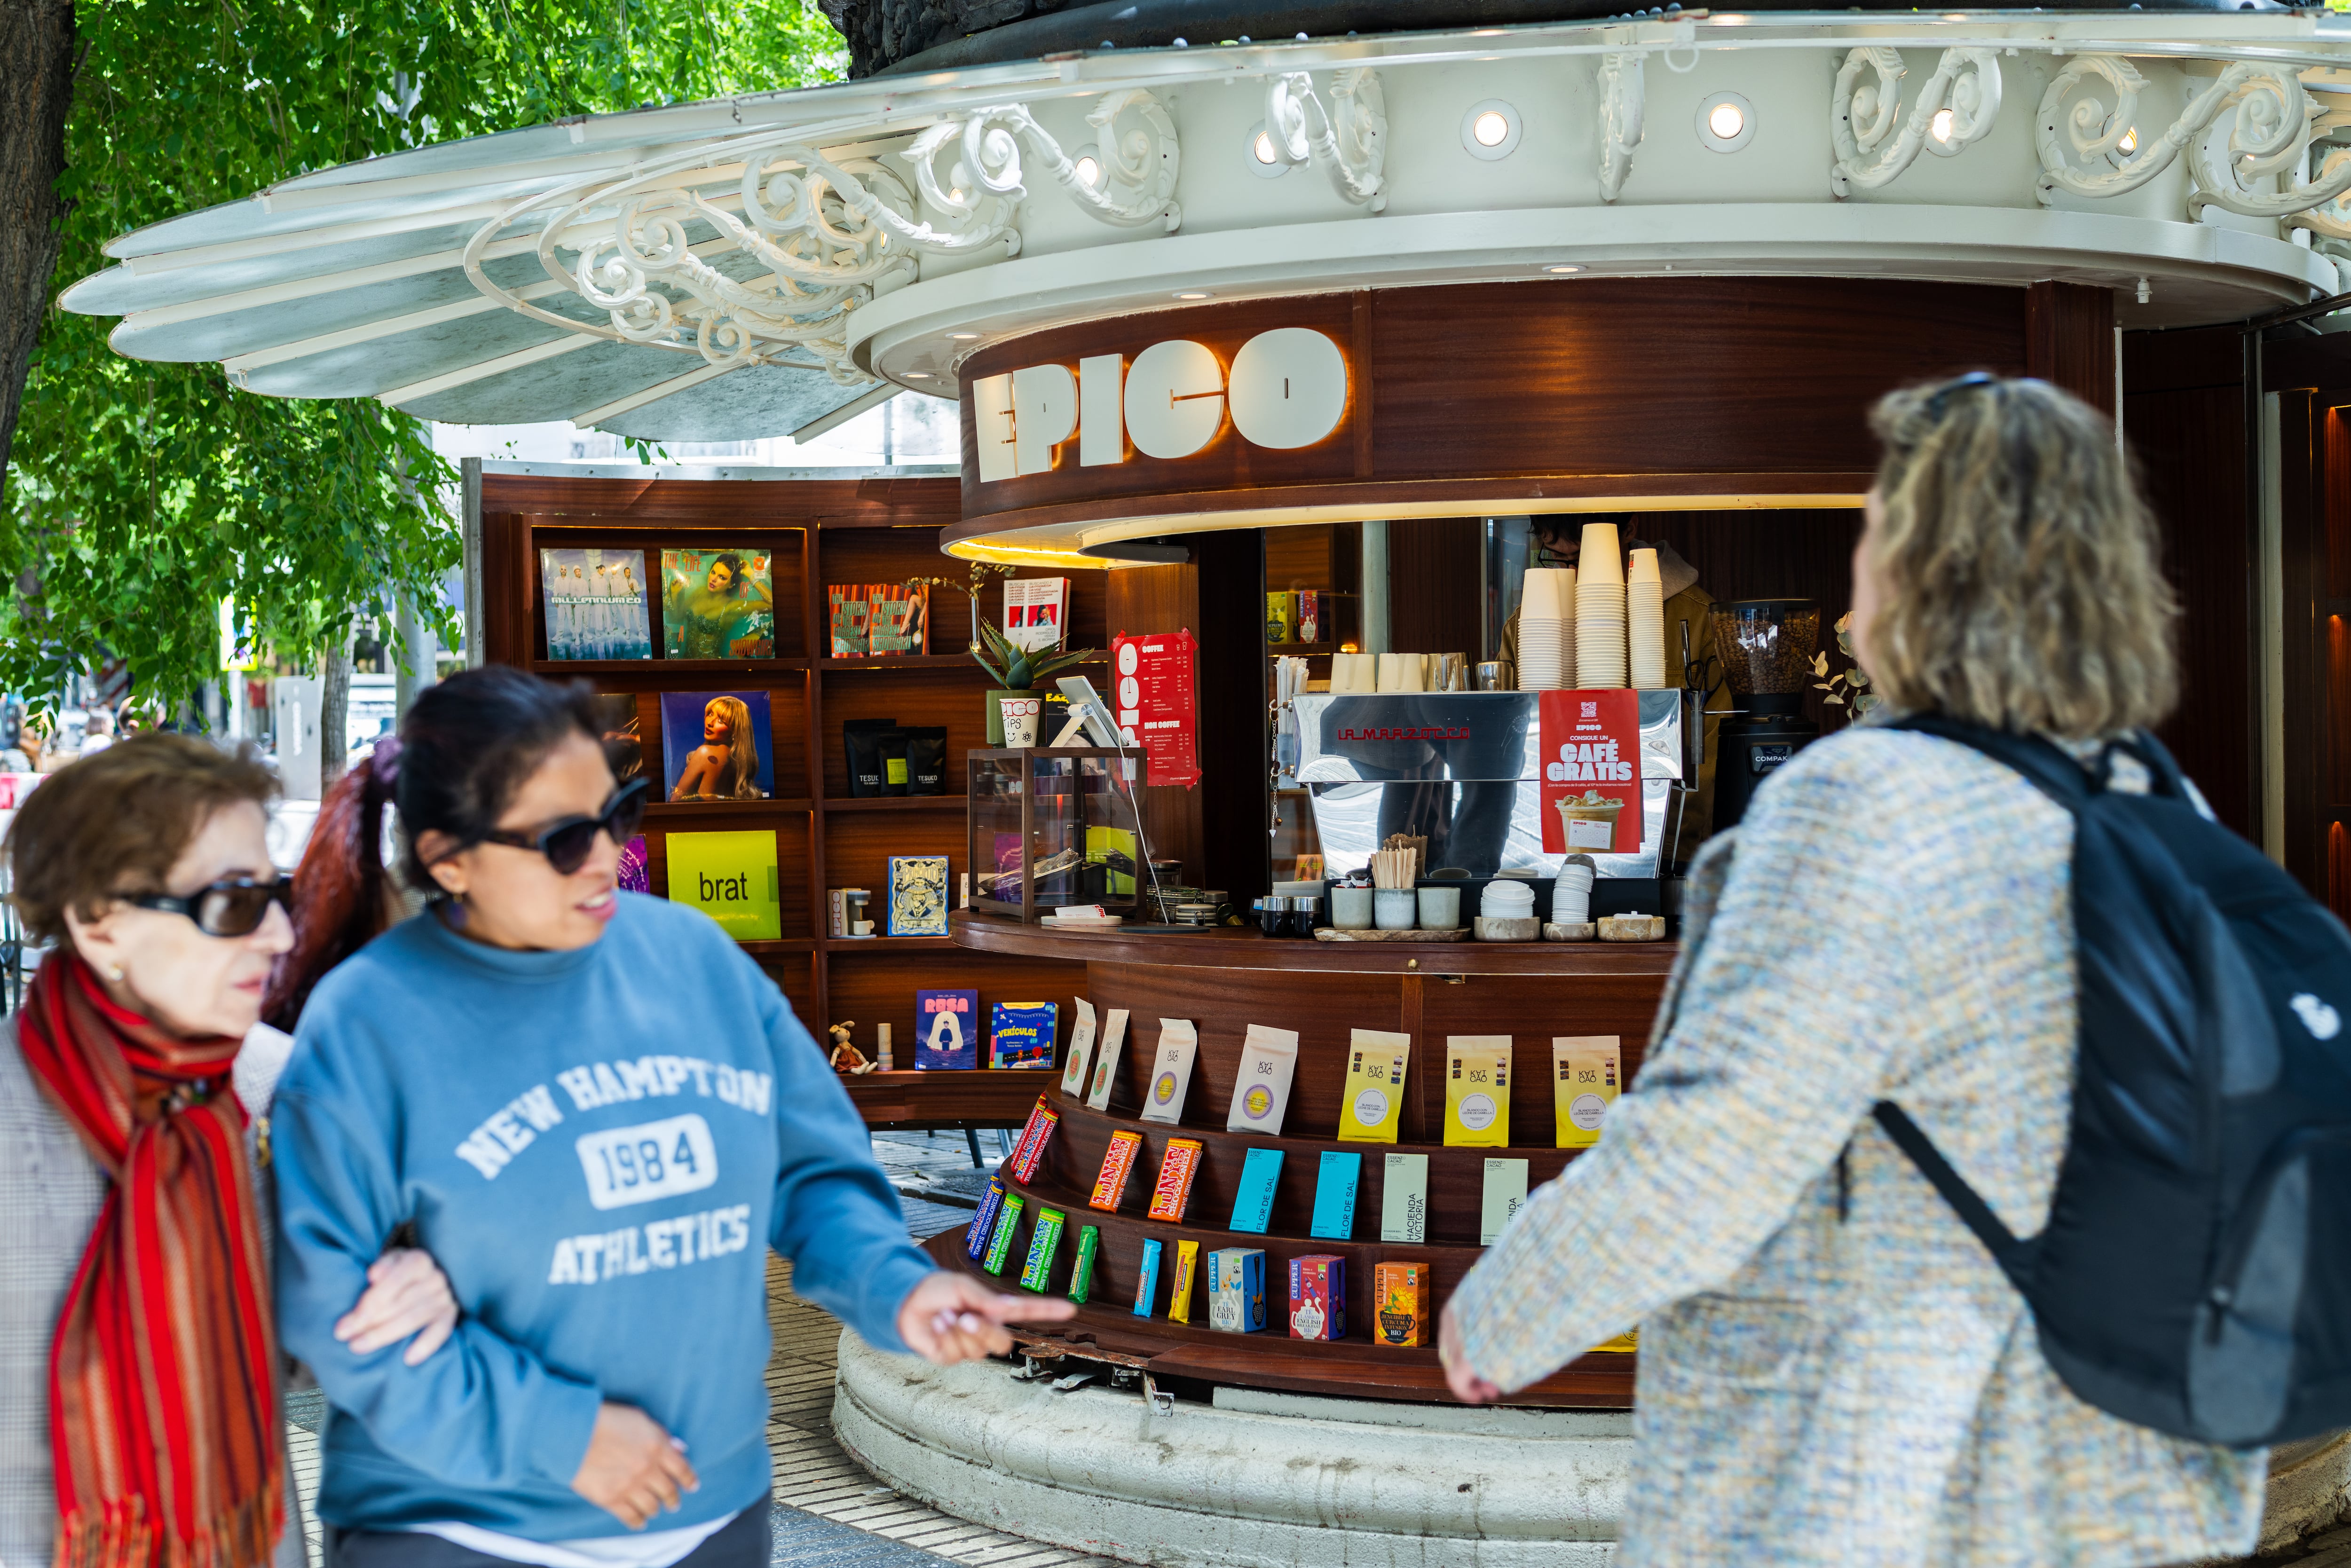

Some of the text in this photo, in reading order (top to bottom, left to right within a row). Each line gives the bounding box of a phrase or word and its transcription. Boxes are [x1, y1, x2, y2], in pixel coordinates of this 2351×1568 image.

[973, 327, 1347, 482] EPICO
[663, 552, 702, 572] THE LIFE
[739, 582, 751, 599] OF
[833, 594, 843, 603] THE
[873, 594, 883, 603] THE
[843, 601, 867, 615] STORY
[884, 601, 907, 615] STORY
[678, 625, 684, 642] A
[835, 627, 860, 637] BIGGEST
[873, 626, 899, 636] BIGGEST
[729, 639, 773, 656] SHOWGIRL
[835, 638, 869, 652] SHOWGIR
[873, 637, 910, 651] SHOWGIRL
[1142, 645, 1164, 653] COFFEE
[1363, 727, 1469, 740] MARZOCCO
[1560, 739, 1619, 763] CAFÉ
[1546, 761, 1632, 781] GRATIS
[699, 872, 748, 901] brat
[832, 890, 842, 936] EPICO
[925, 998, 969, 1013] ROSA
[454, 1055, 773, 1181] NEW HAMPTON
[599, 1132, 699, 1191] 1984
[1256, 1176, 1275, 1230] FLOR DE SAL
[1344, 1200, 1352, 1212] DE
[1407, 1193, 1416, 1240] HACIENDA
[1414, 1198, 1423, 1241] VICTORIA
[1341, 1214, 1350, 1237] FLOR
[548, 1203, 751, 1285] ATHLETICS
[1216, 1312, 1236, 1320] GREY
